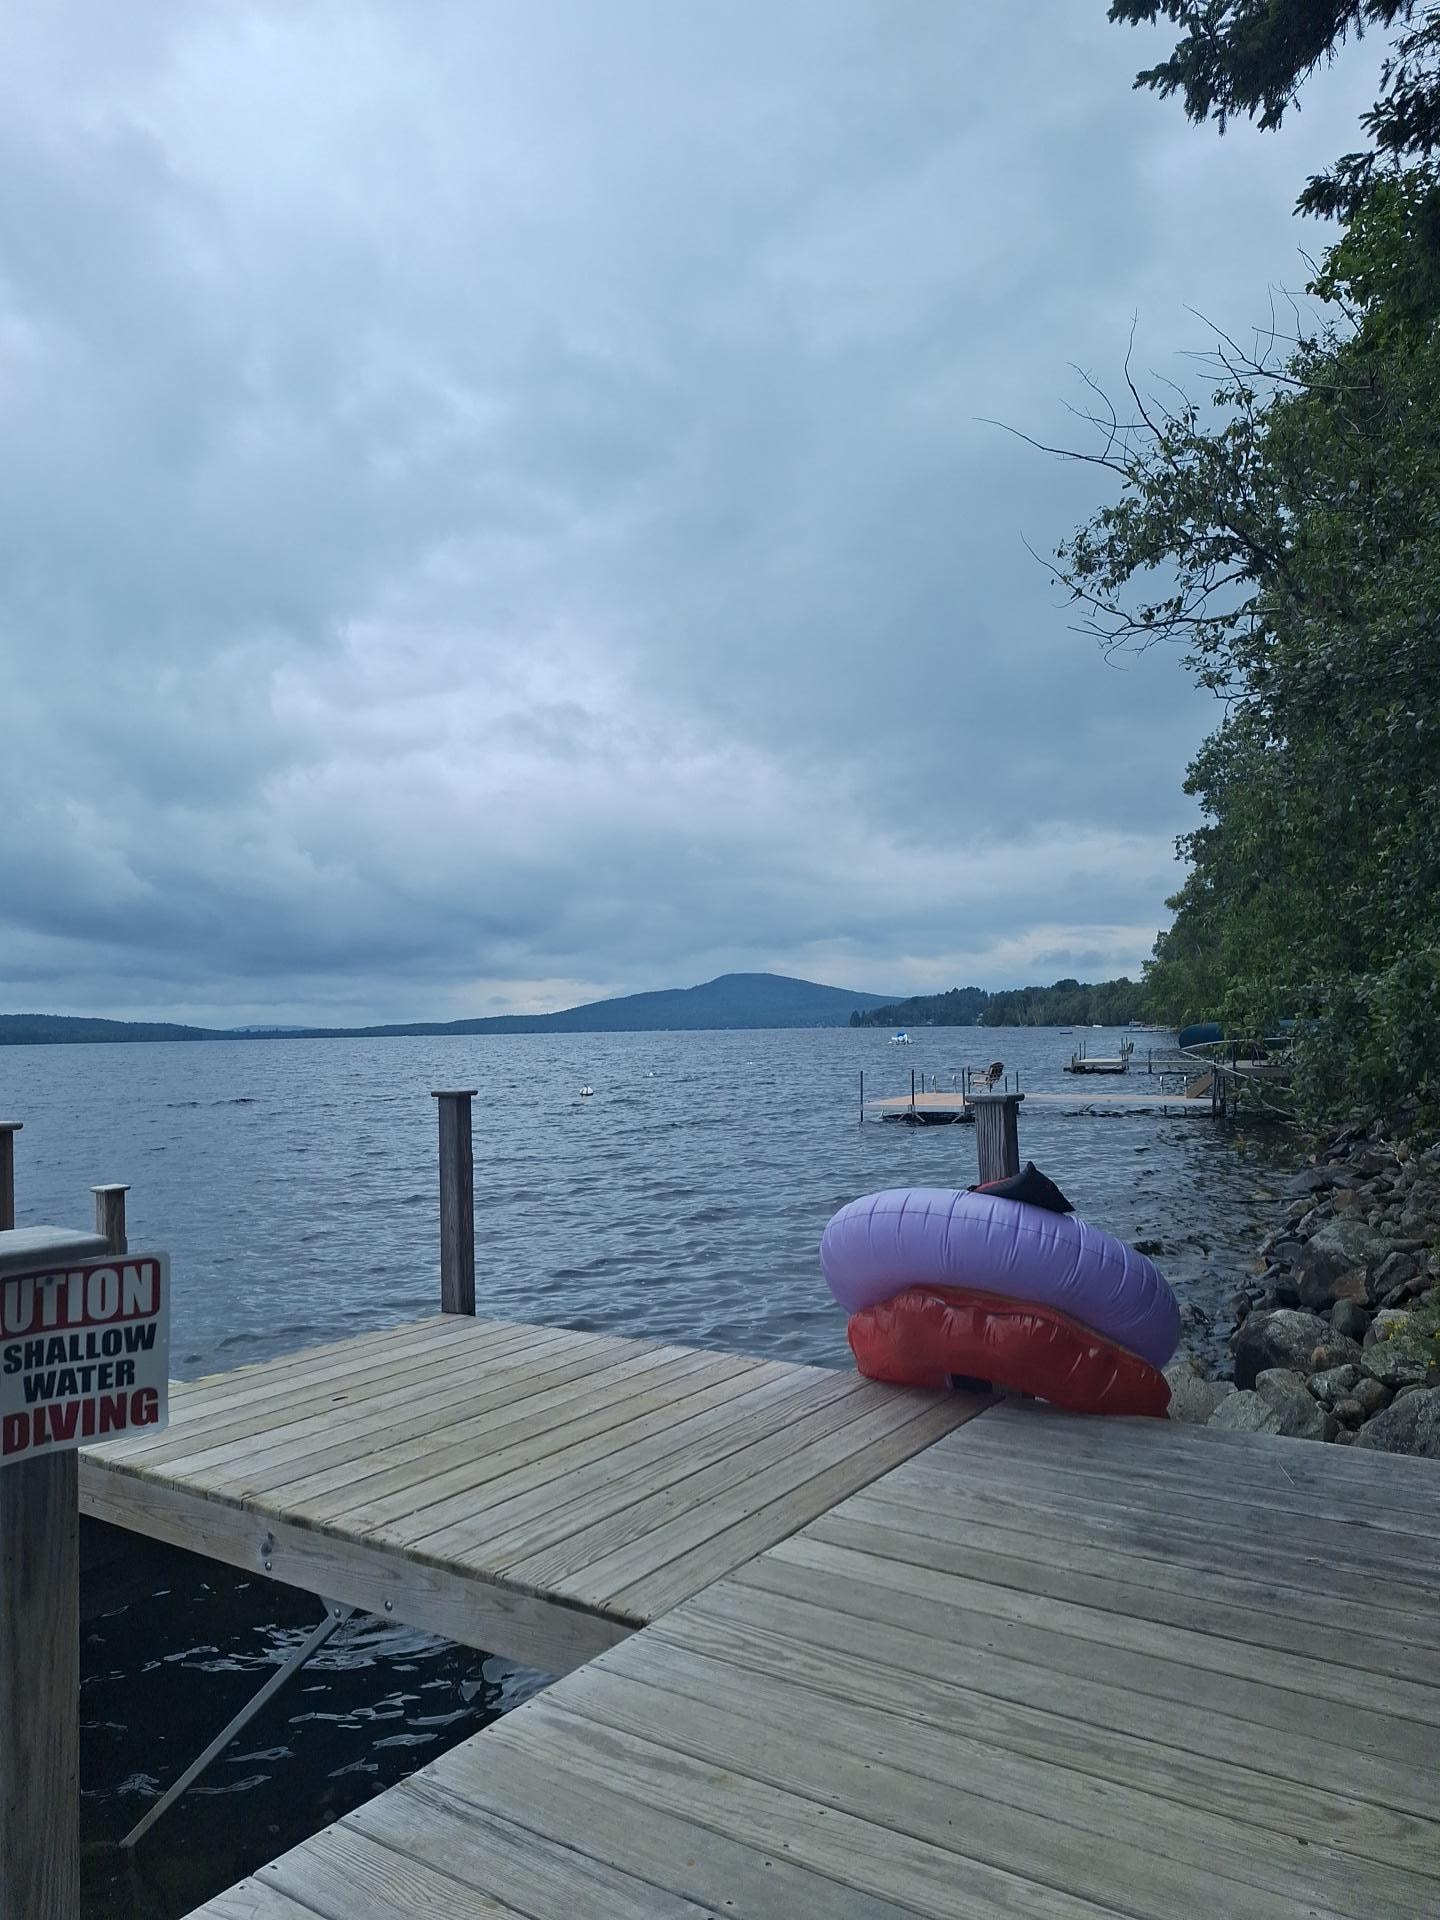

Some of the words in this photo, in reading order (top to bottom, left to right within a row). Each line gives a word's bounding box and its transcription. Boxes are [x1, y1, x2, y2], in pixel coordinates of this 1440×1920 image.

[0, 1262, 153, 1335] UTION
[3, 1322, 157, 1375] SHALLOW
[23, 1358, 136, 1404] WATER
[2, 1387, 159, 1455] DIVING
